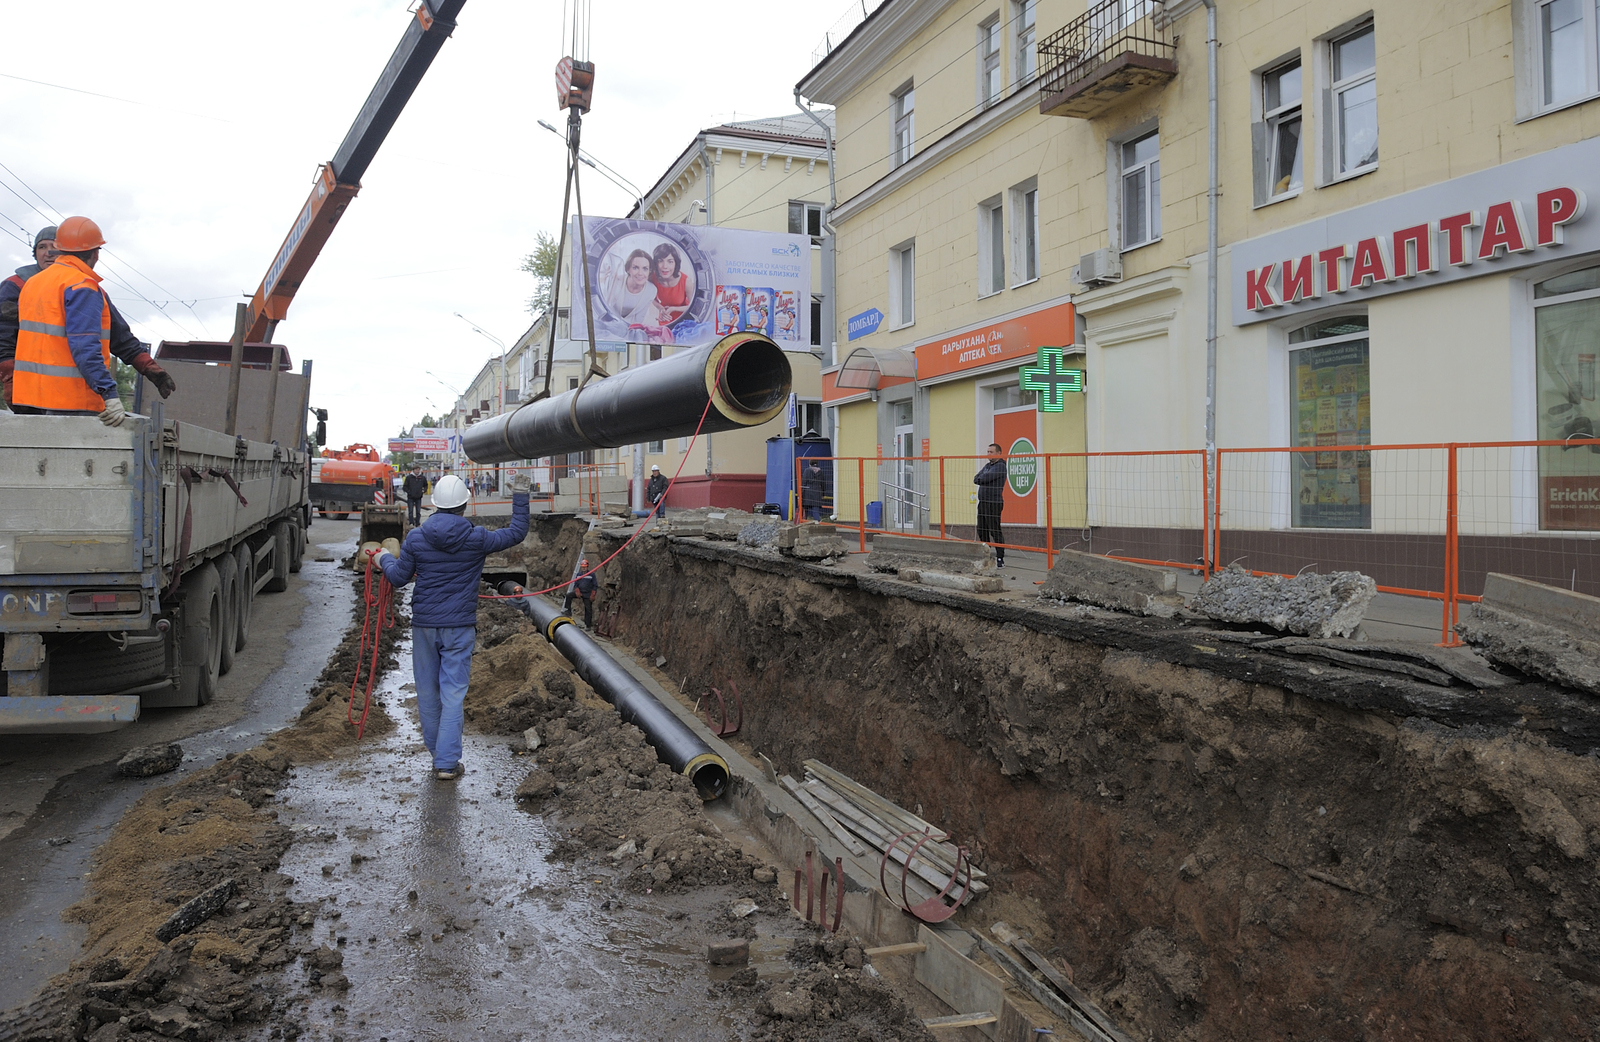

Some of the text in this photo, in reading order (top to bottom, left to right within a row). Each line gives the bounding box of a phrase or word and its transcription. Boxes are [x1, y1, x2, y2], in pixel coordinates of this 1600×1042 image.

[265, 203, 311, 295] КЛИНЦЫ
[1246, 186, 1584, 312] КИТАПТАР
[725, 260, 764, 269] ЗАБОТИМСЯ
[771, 263, 801, 272] КАЧЕСТВЕ
[742, 268, 767, 276] САМЫХ
[769, 270, 799, 278] БЛИЗКИХ
[848, 312, 880, 334] ЛОМБАРД
[959, 347, 986, 364] АПТЕКА
[1010, 451, 1035, 463] АПТЕКА
[1009, 463, 1035, 475] НИЗКИХ
[1016, 475, 1029, 489] ЦЕН
[1550, 487, 1600, 501] ErichK
